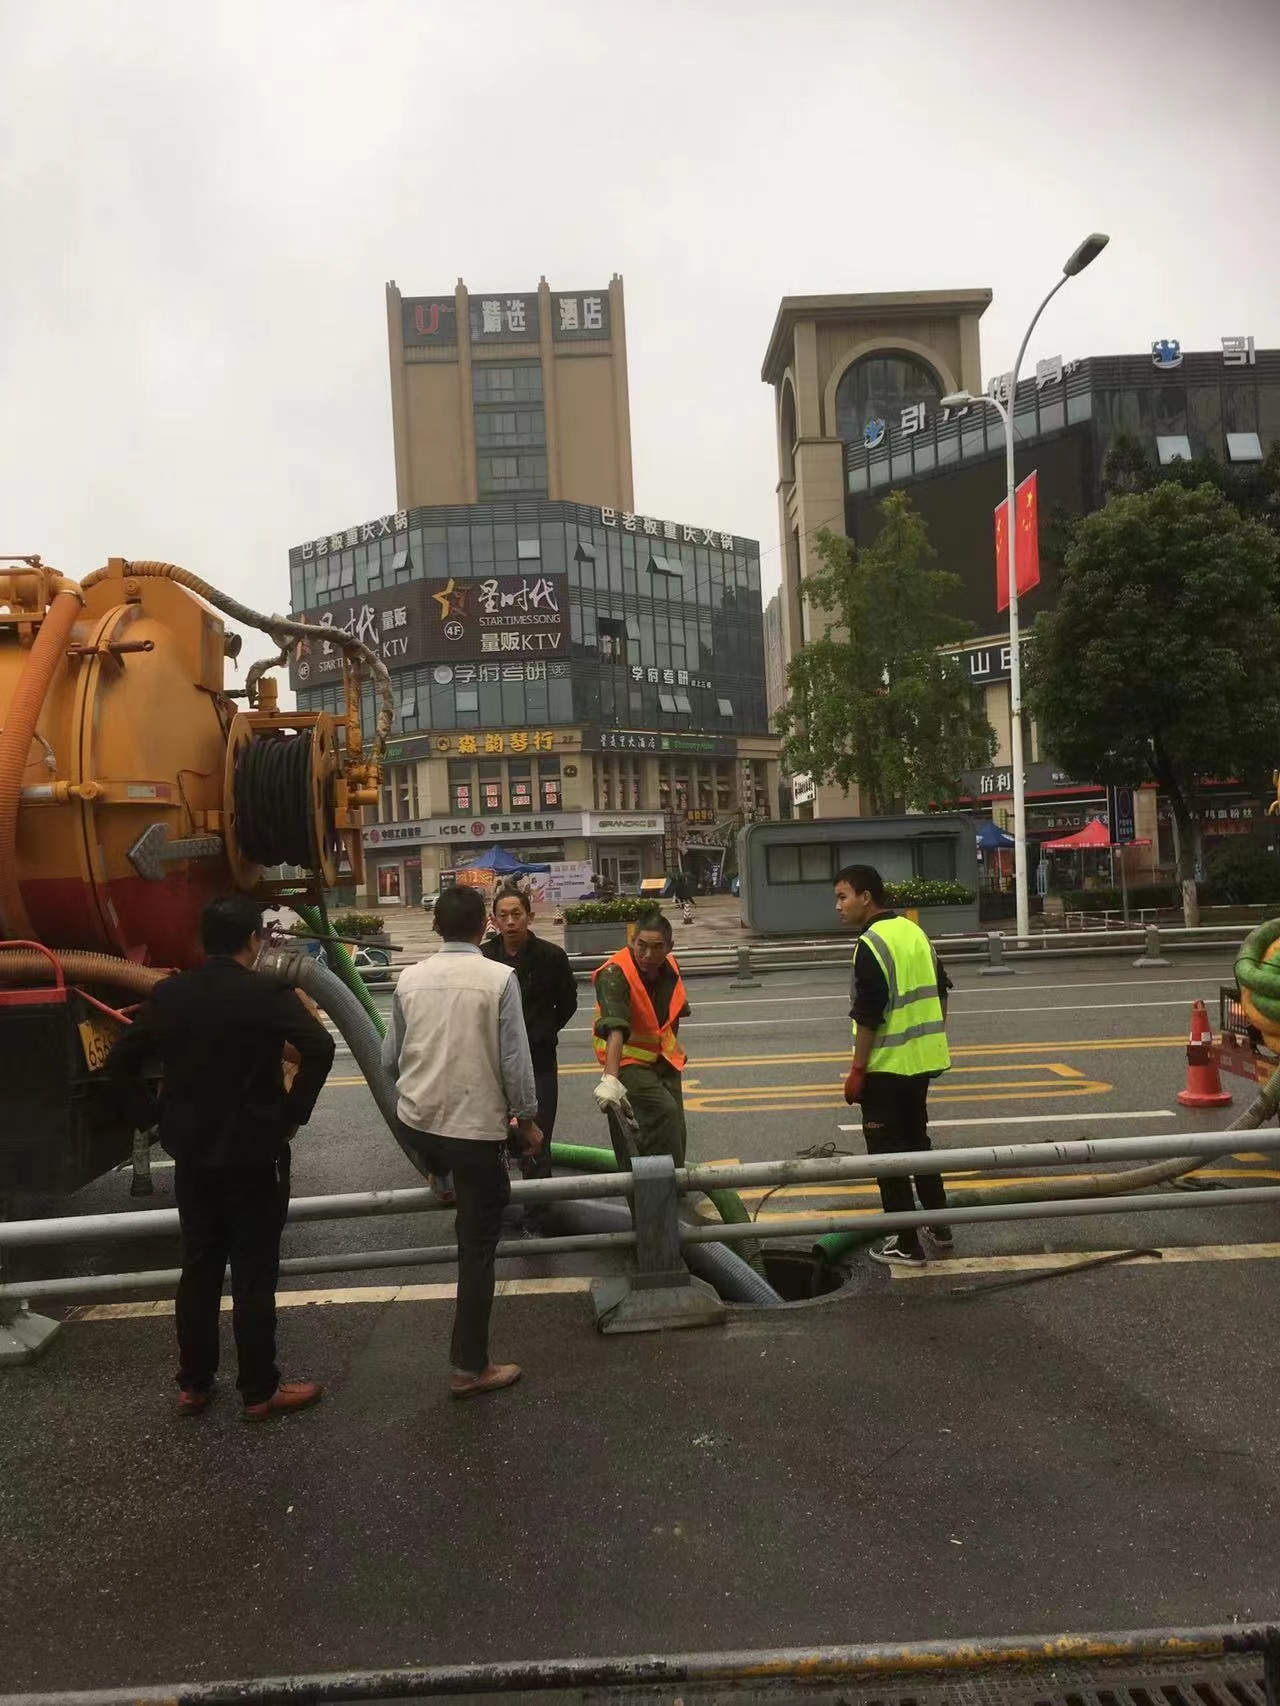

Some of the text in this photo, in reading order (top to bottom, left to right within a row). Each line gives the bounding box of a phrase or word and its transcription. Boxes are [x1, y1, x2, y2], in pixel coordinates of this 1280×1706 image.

[559, 297, 602, 331] 酒店
[1220, 335, 1257, 366] 引
[301, 509, 408, 560] 巴老板重庆火锅
[601, 506, 734, 551] 巴老板重庆火锅
[478, 578, 560, 614] 星时代
[319, 604, 380, 655] 星代
[446, 626, 461, 636] 4F
[382, 636, 409, 658] KTV
[480, 632, 562, 653] 量贩KTV
[454, 661, 547, 684] 学府考研
[632, 665, 689, 686] 学府考研
[980, 771, 1027, 794] 佰利
[381, 826, 422, 839] 中国工商银行
[439, 825, 466, 835] ICBC
[490, 819, 556, 833] 中国工商银行
